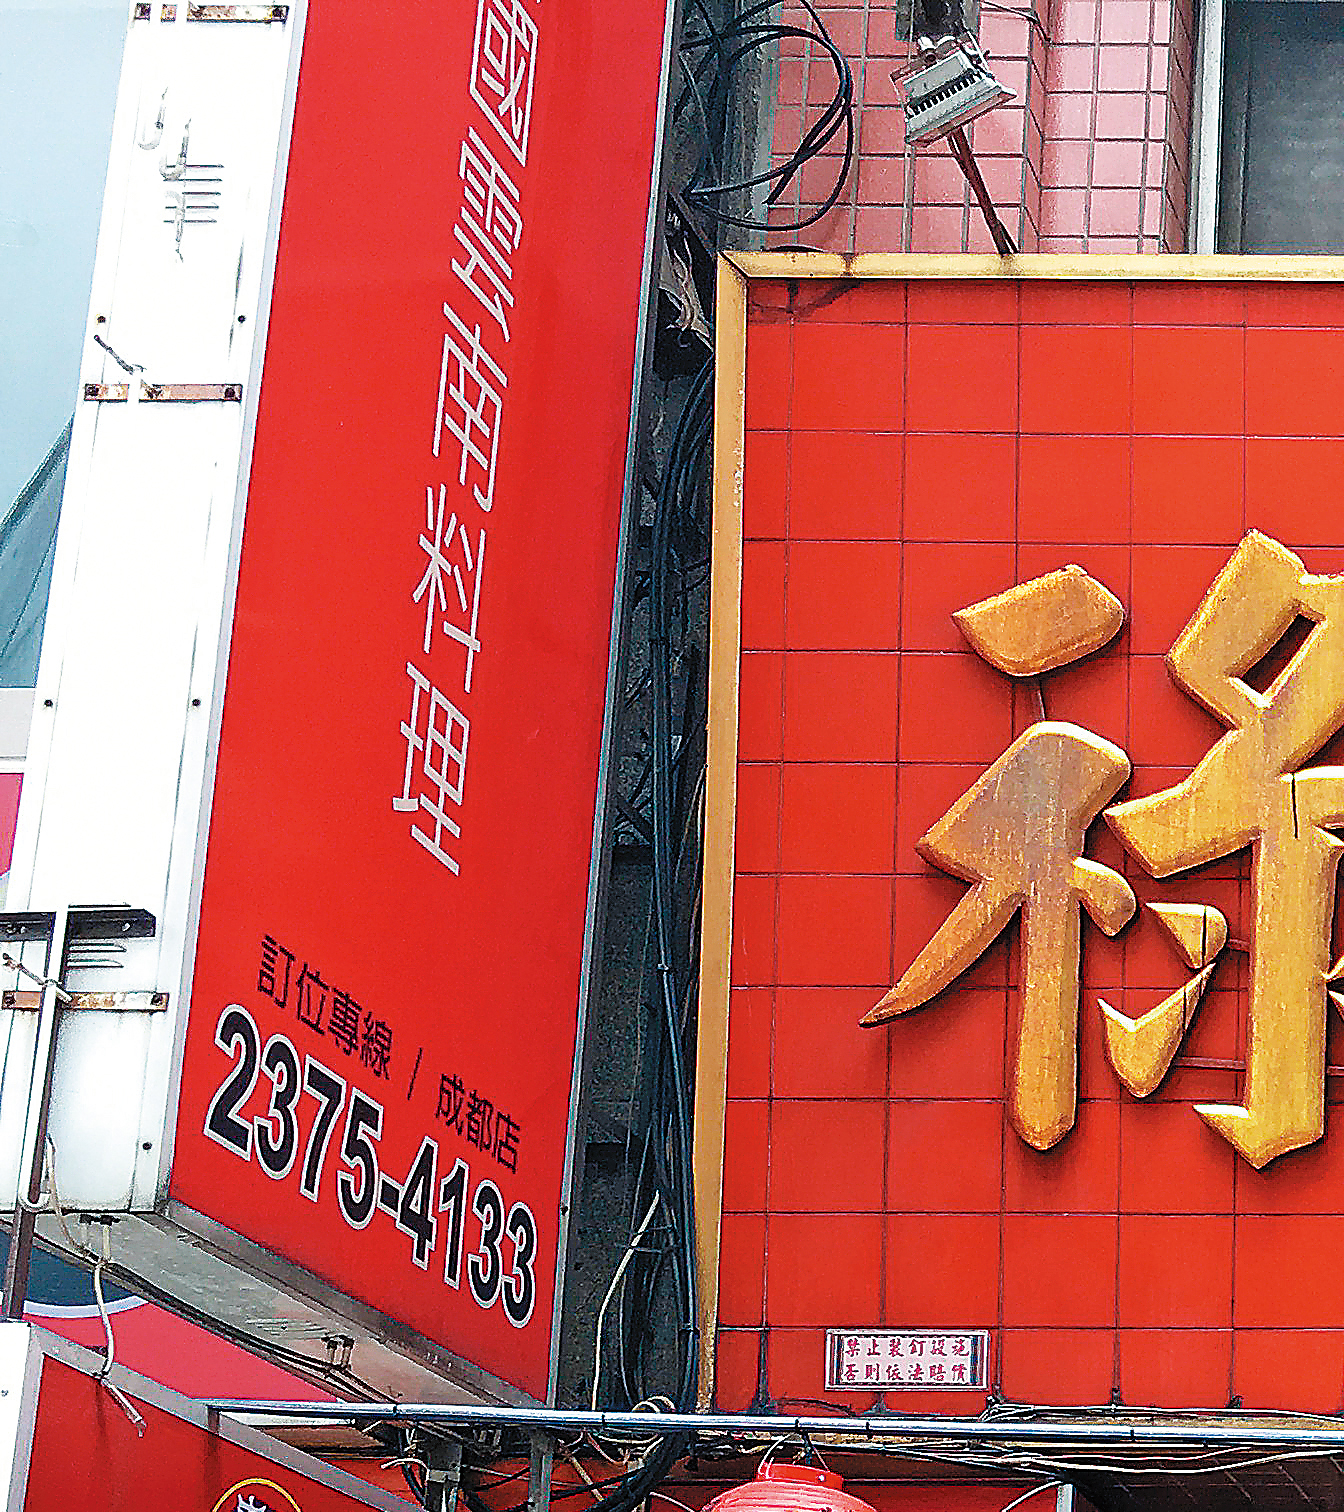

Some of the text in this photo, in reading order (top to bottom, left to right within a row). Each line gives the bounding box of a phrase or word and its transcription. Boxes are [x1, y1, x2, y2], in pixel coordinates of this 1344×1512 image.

[204, 1003, 538, 1328] 2375-4133
[257, 934, 393, 1081] 訂位專線
[435, 1072, 521, 1174] 成都店
